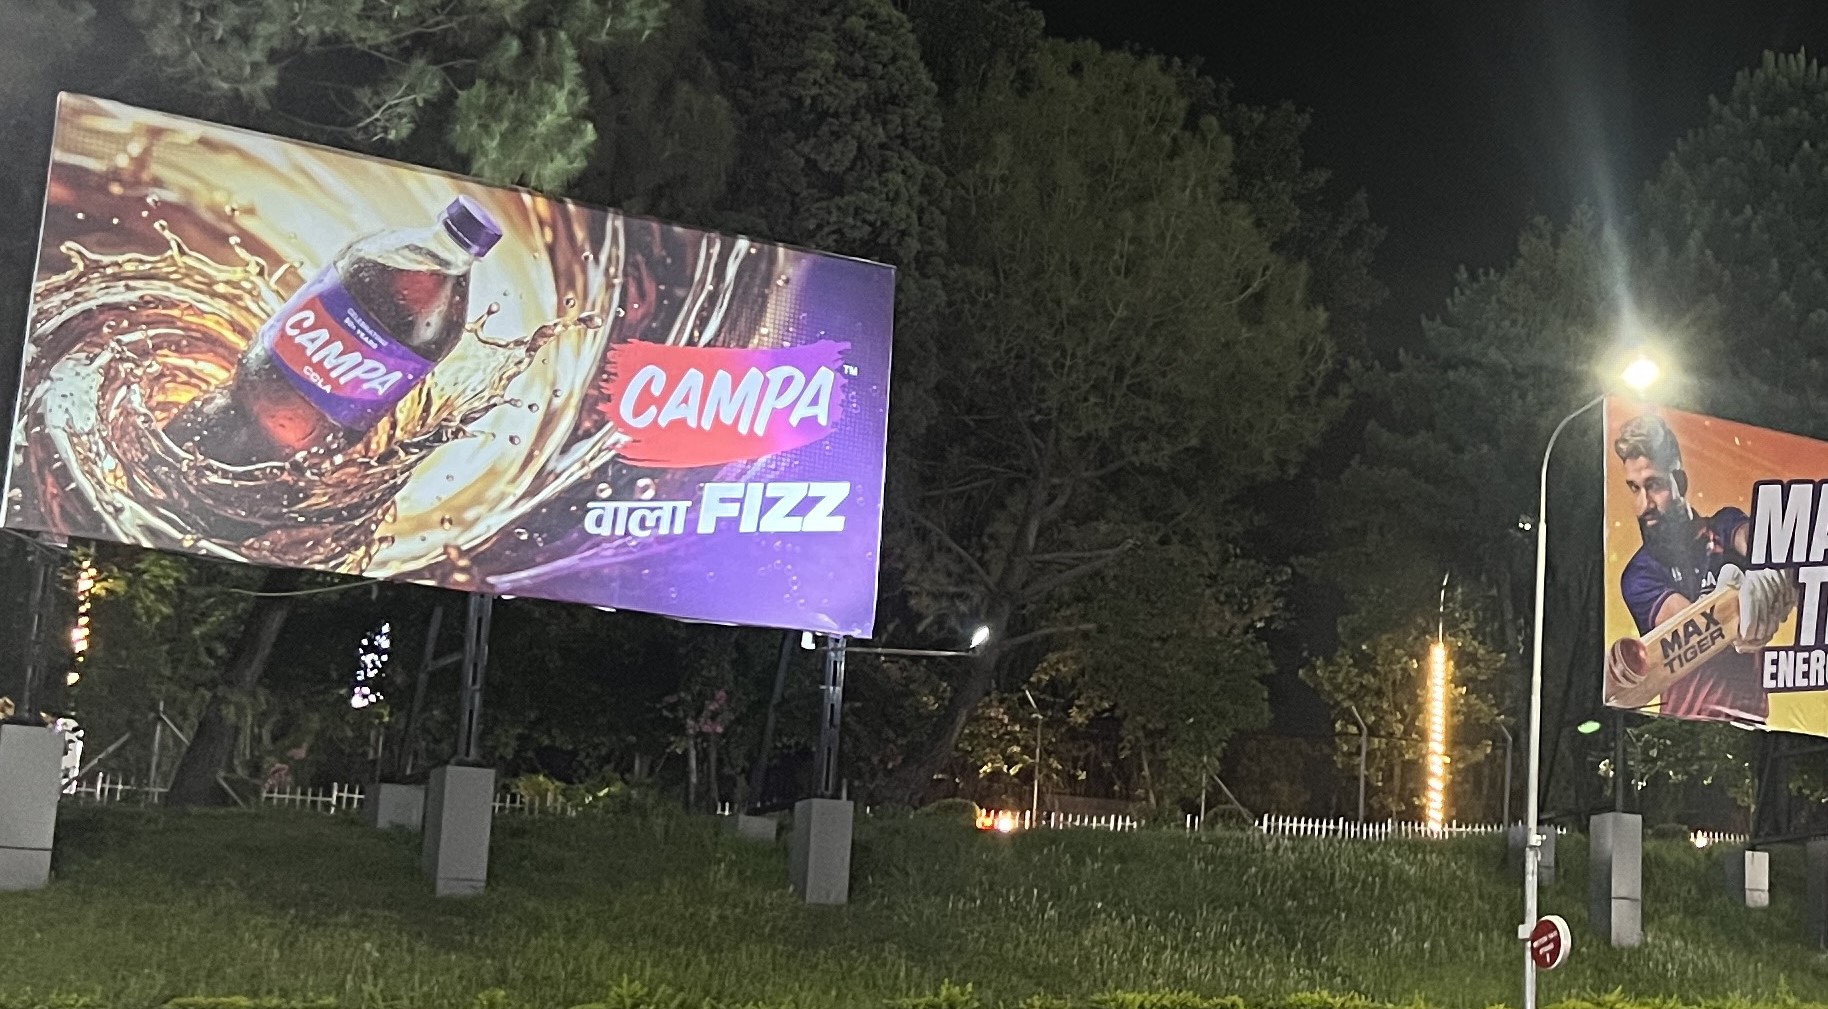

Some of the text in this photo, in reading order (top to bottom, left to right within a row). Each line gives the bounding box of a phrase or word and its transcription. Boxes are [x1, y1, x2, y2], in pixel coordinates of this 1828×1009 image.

[285, 310, 403, 396] CAMPA
[303, 366, 332, 394] COLA
[619, 365, 834, 437] CAMPA
[584, 482, 850, 537] वाला FIZZ
[1659, 604, 1720, 660] MAX
[1664, 627, 1725, 674] TIGER
